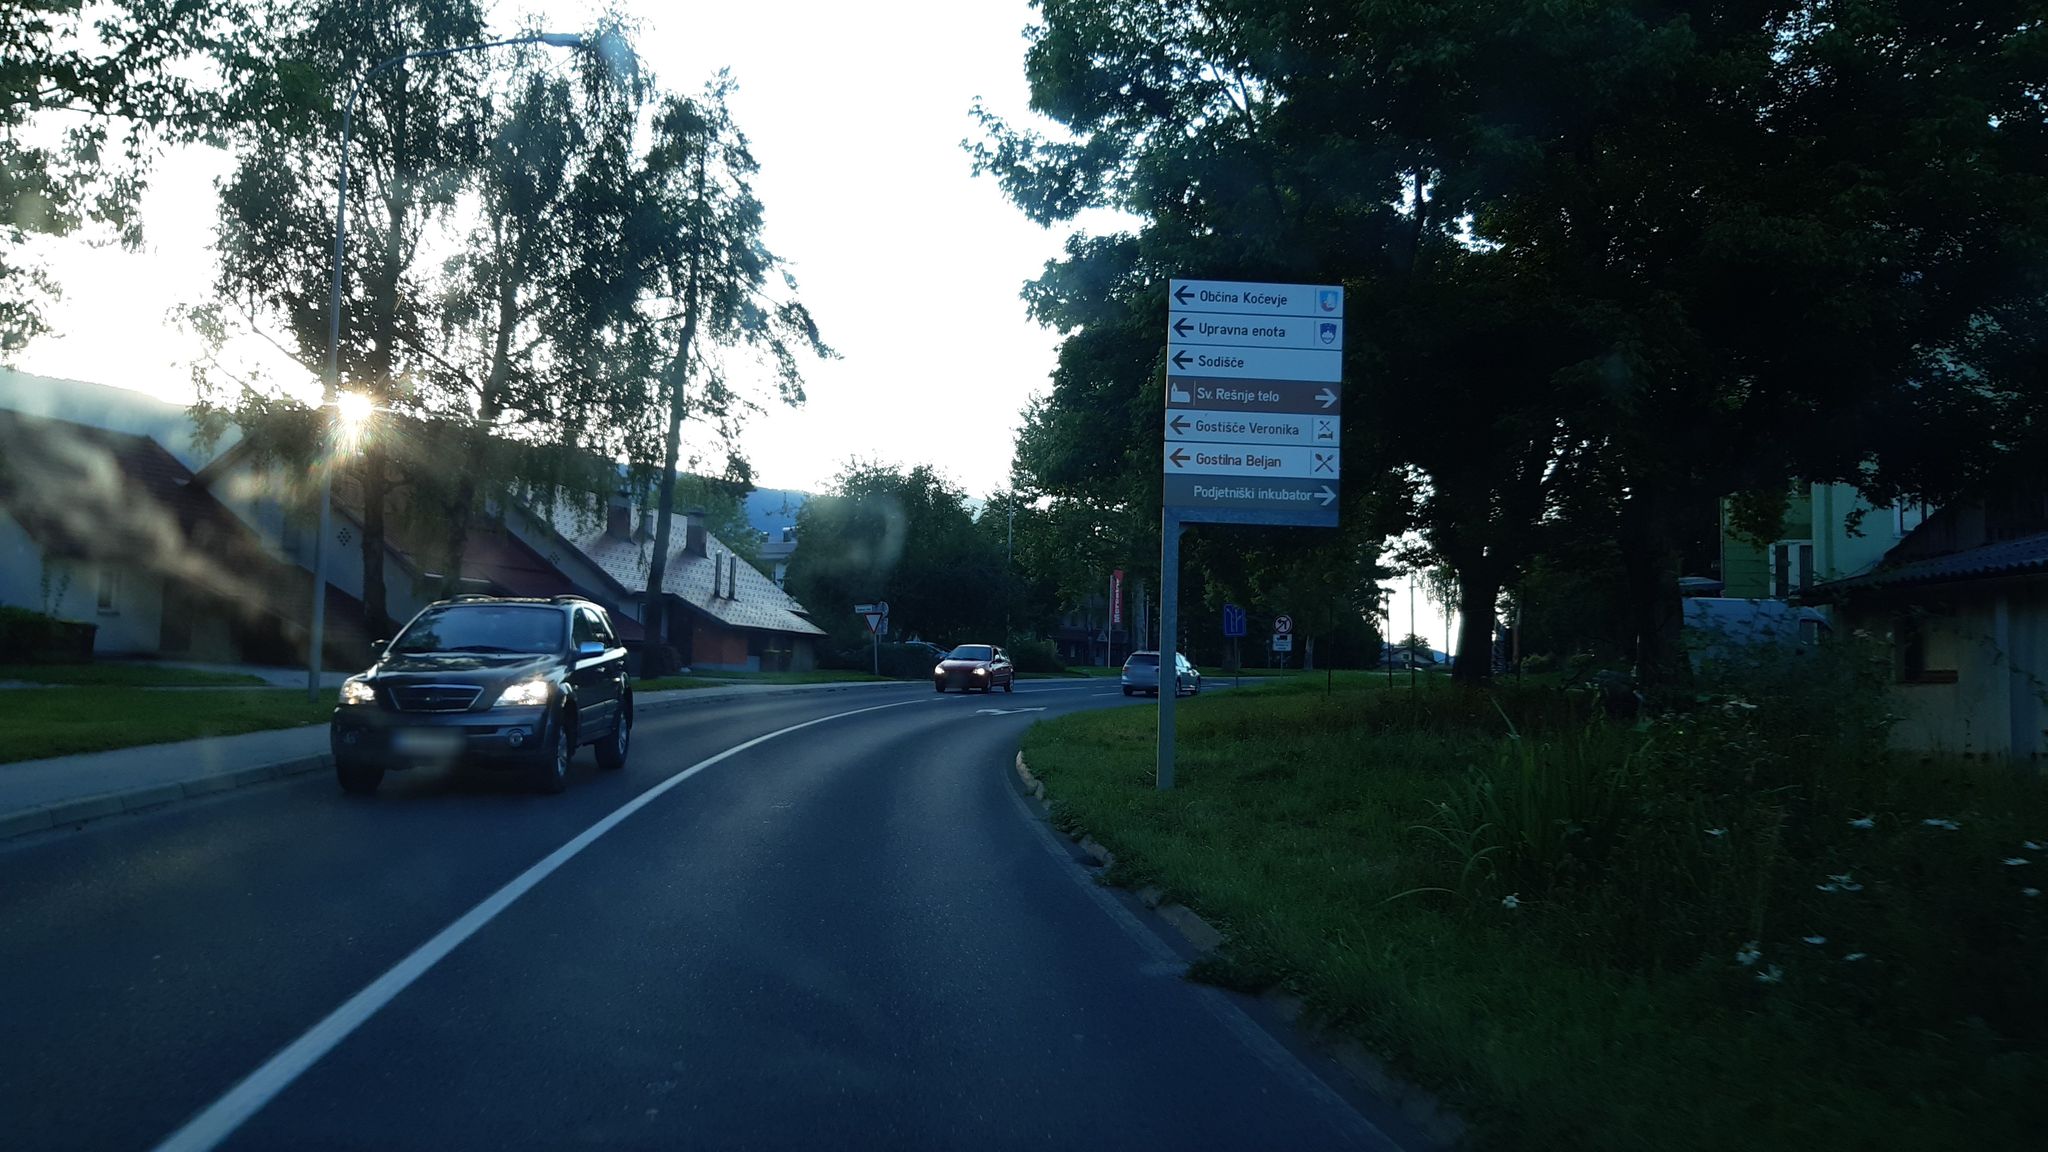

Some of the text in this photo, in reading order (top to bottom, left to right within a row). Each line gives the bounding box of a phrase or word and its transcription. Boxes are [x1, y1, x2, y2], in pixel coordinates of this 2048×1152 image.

[1200, 290, 1288, 307] Občina Kočevje
[1199, 322, 1286, 338] Upravna enota
[1198, 355, 1244, 368] Sodišče
[1197, 387, 1280, 404] Sv. Rešnje telo
[1196, 420, 1299, 436] Gostišče Veronika
[1196, 452, 1282, 470] Gostilna Beljan
[1193, 485, 1313, 502] Podjetniški inkubator
